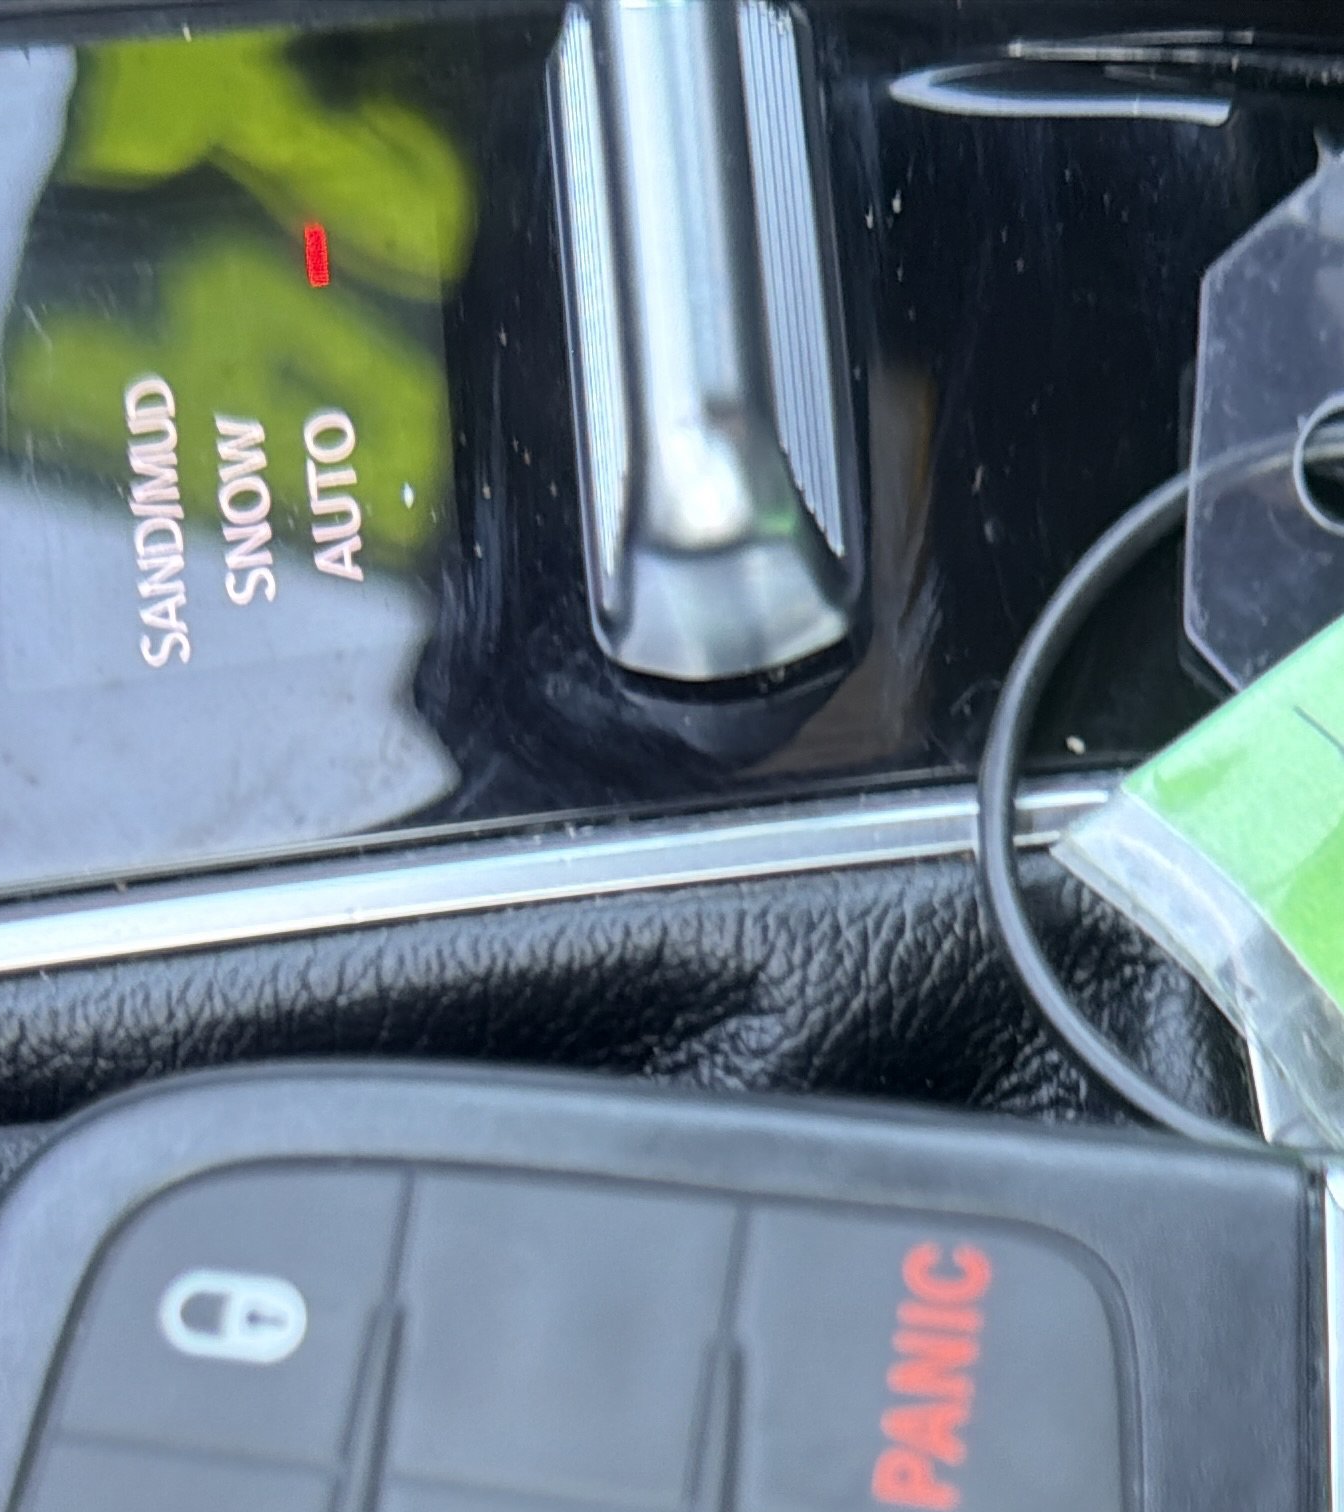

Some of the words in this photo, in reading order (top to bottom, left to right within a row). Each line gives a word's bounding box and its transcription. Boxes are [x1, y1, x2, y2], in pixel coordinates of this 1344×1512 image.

[214, 413, 276, 605] SNOW
[304, 410, 364, 581] AUTO
[871, 1240, 993, 1512] PANIC
